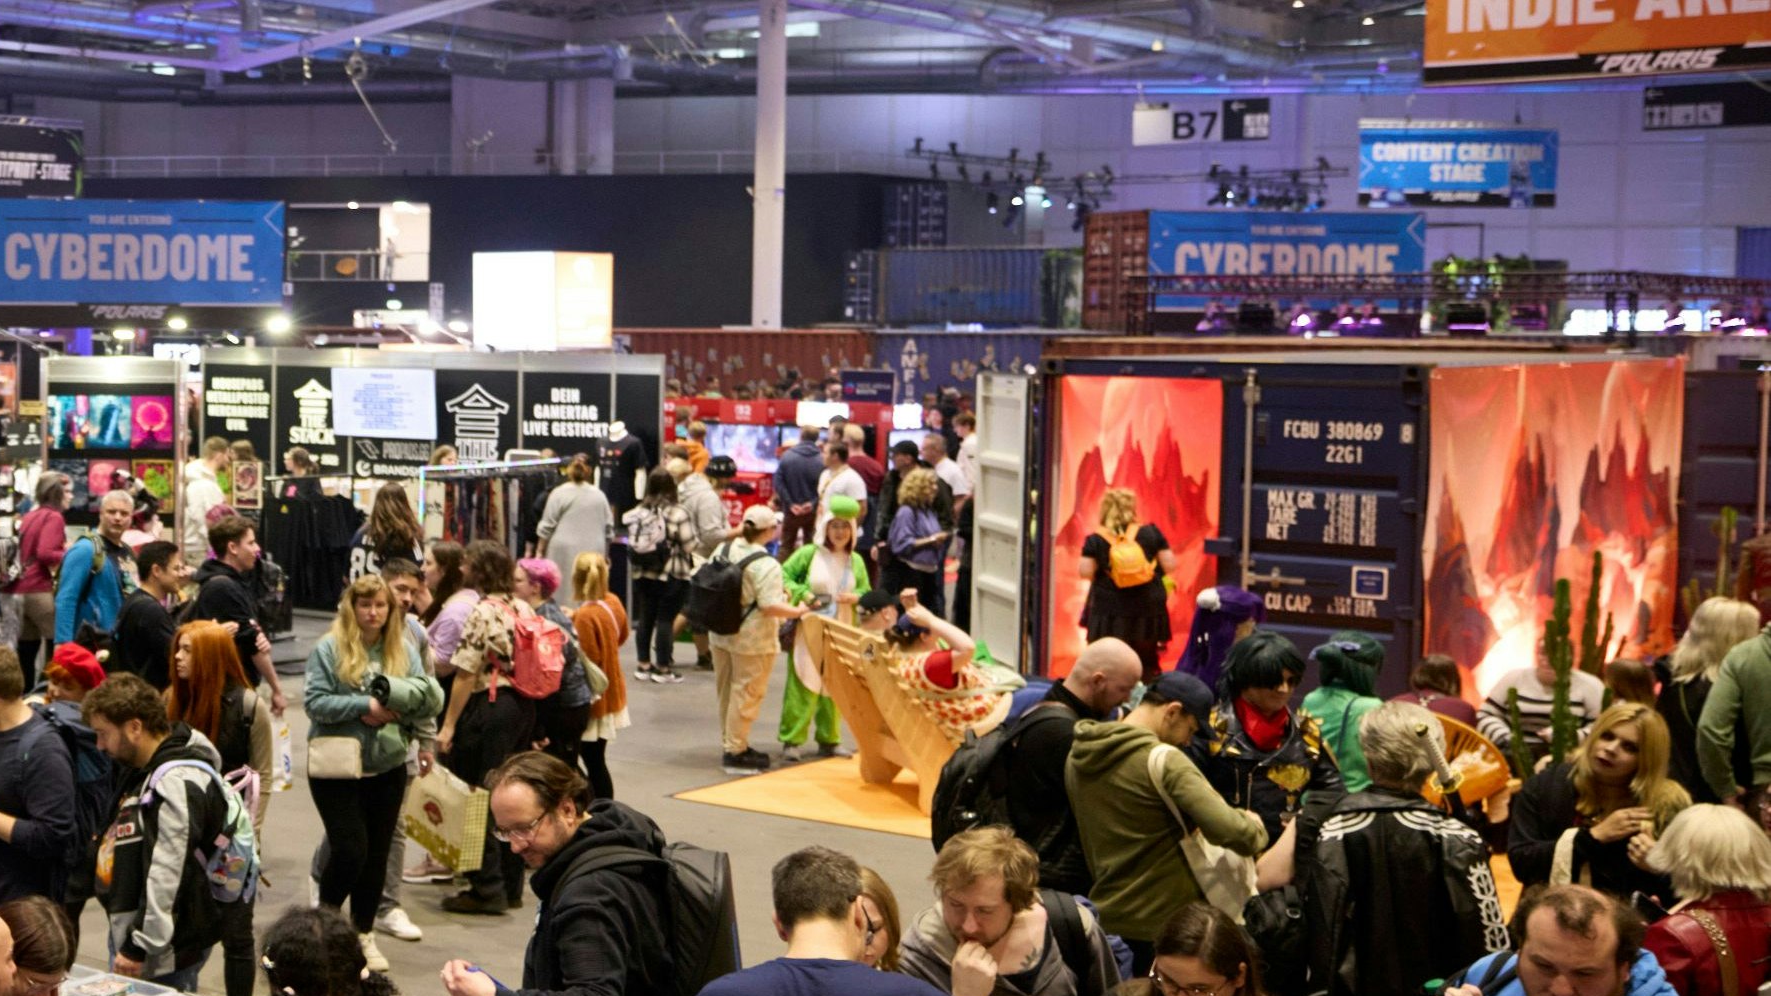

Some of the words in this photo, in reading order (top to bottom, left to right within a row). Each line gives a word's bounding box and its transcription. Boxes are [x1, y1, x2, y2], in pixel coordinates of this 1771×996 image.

[1600, 48, 1726, 73] POLARIS
[1172, 111, 1218, 140] B7
[1372, 142, 1453, 162] CONTENT
[1457, 143, 1545, 163] CREATION
[1429, 163, 1486, 183] STAGE
[4, 232, 255, 283] CYBERDOME
[93, 305, 168, 320] POLARIS
[550, 387, 581, 403] DEIN
[532, 403, 599, 421] GAMERTAG
[522, 420, 551, 436] LIVE
[1283, 420, 1320, 438] FCBU
[1326, 421, 1384, 440] 380869
[1400, 424, 1415, 443] 8
[1266, 523, 1288, 540] NET
